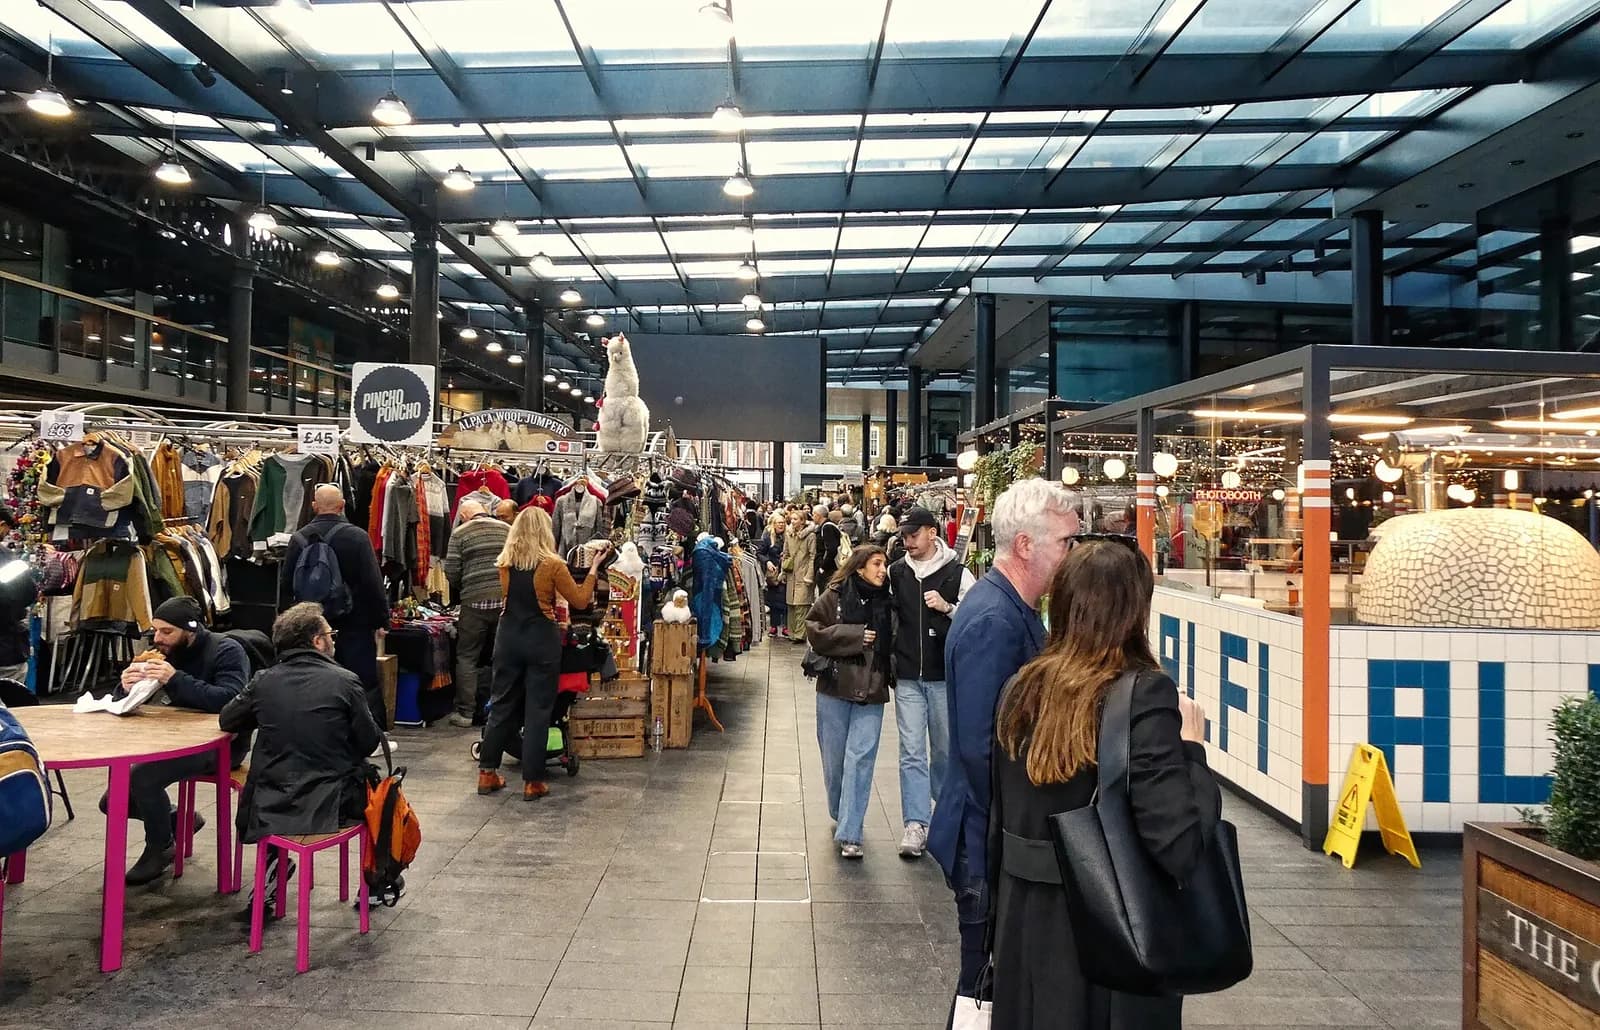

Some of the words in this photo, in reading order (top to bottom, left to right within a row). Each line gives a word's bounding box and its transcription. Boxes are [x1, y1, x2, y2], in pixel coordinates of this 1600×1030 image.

[362, 388, 404, 410] PINCHO
[376, 402, 421, 424] PONCHO
[458, 412, 494, 432] ALPACA
[495, 410, 523, 423] WOOL
[524, 413, 570, 438] JUMPERS
[48, 422, 74, 437] £65
[303, 431, 333, 444] £45
[1195, 489, 1261, 501] PHOTOBOOTH
[1367, 659, 1600, 804] AL
[1506, 909, 1580, 983] THE
